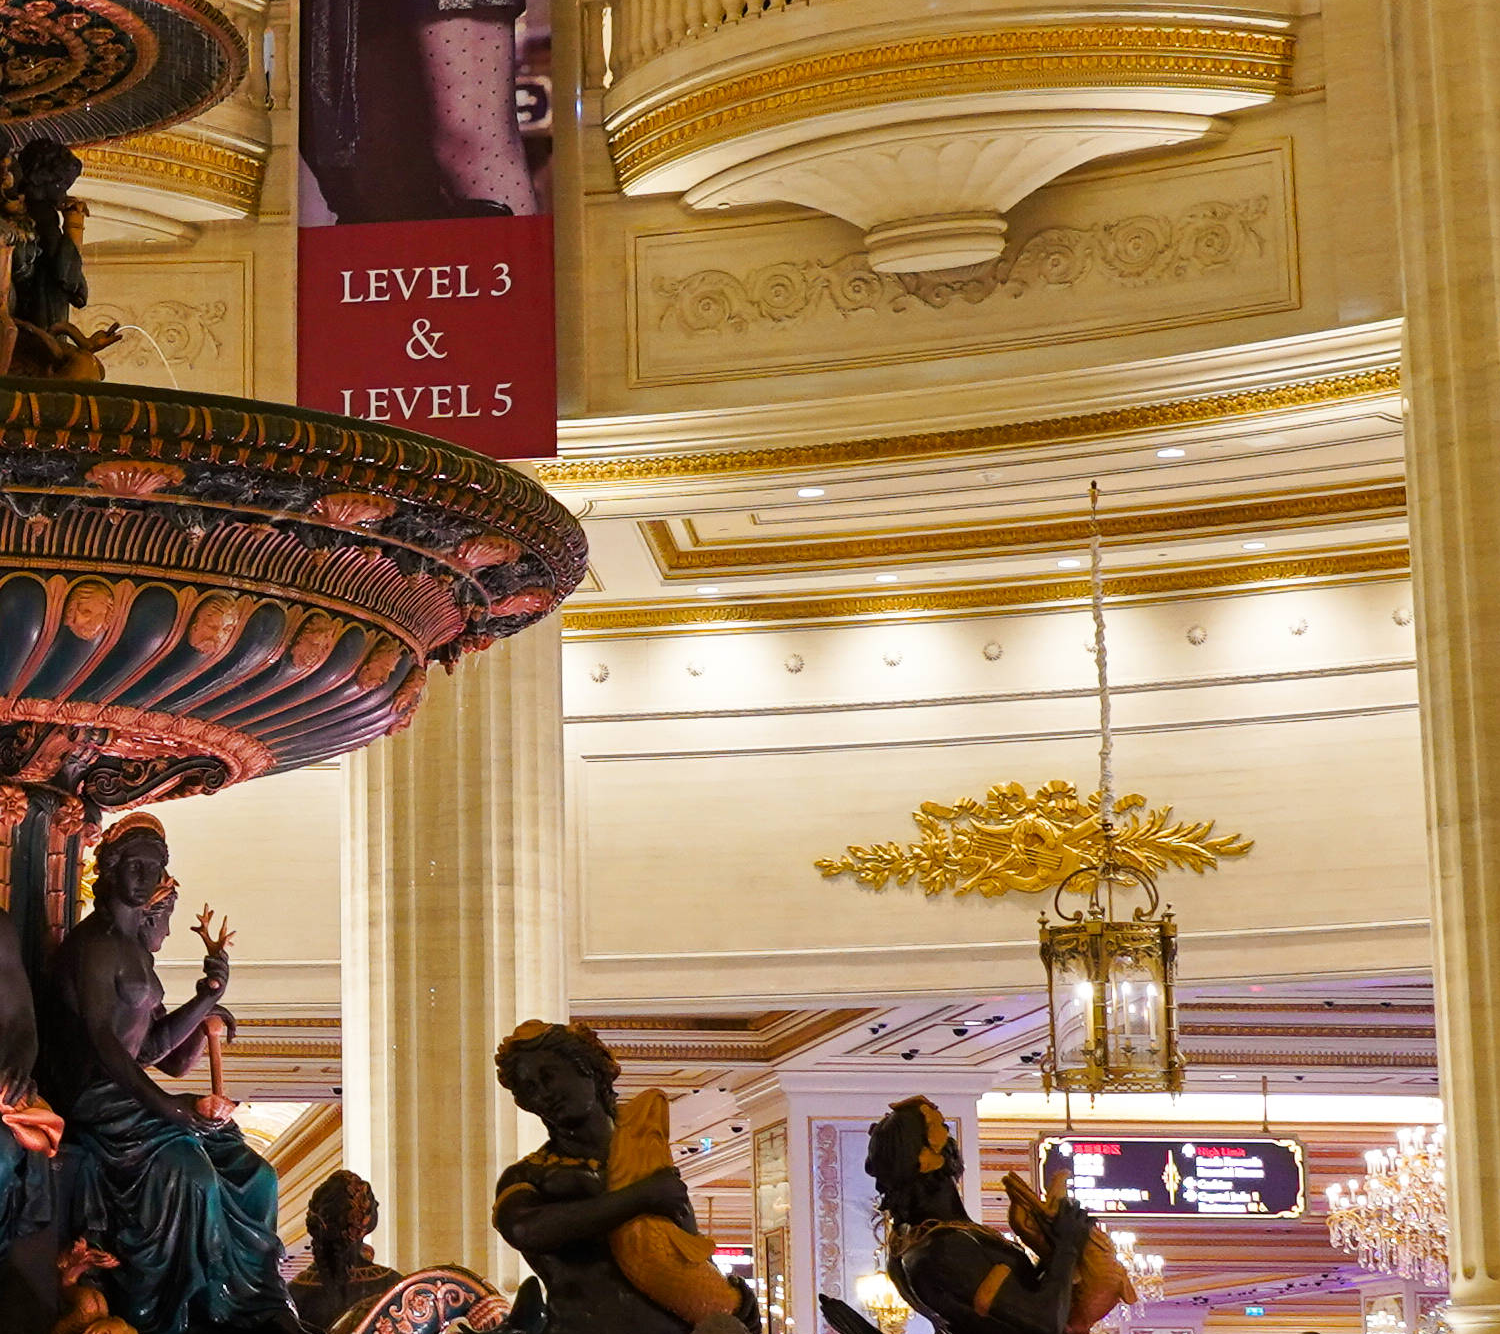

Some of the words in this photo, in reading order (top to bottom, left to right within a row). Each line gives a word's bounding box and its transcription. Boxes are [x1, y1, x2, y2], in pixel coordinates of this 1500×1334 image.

[340, 265, 480, 303] LEVEL
[490, 262, 512, 297] 3
[405, 318, 448, 360] &
[340, 384, 481, 421] LEVEL
[491, 382, 513, 417] 5
